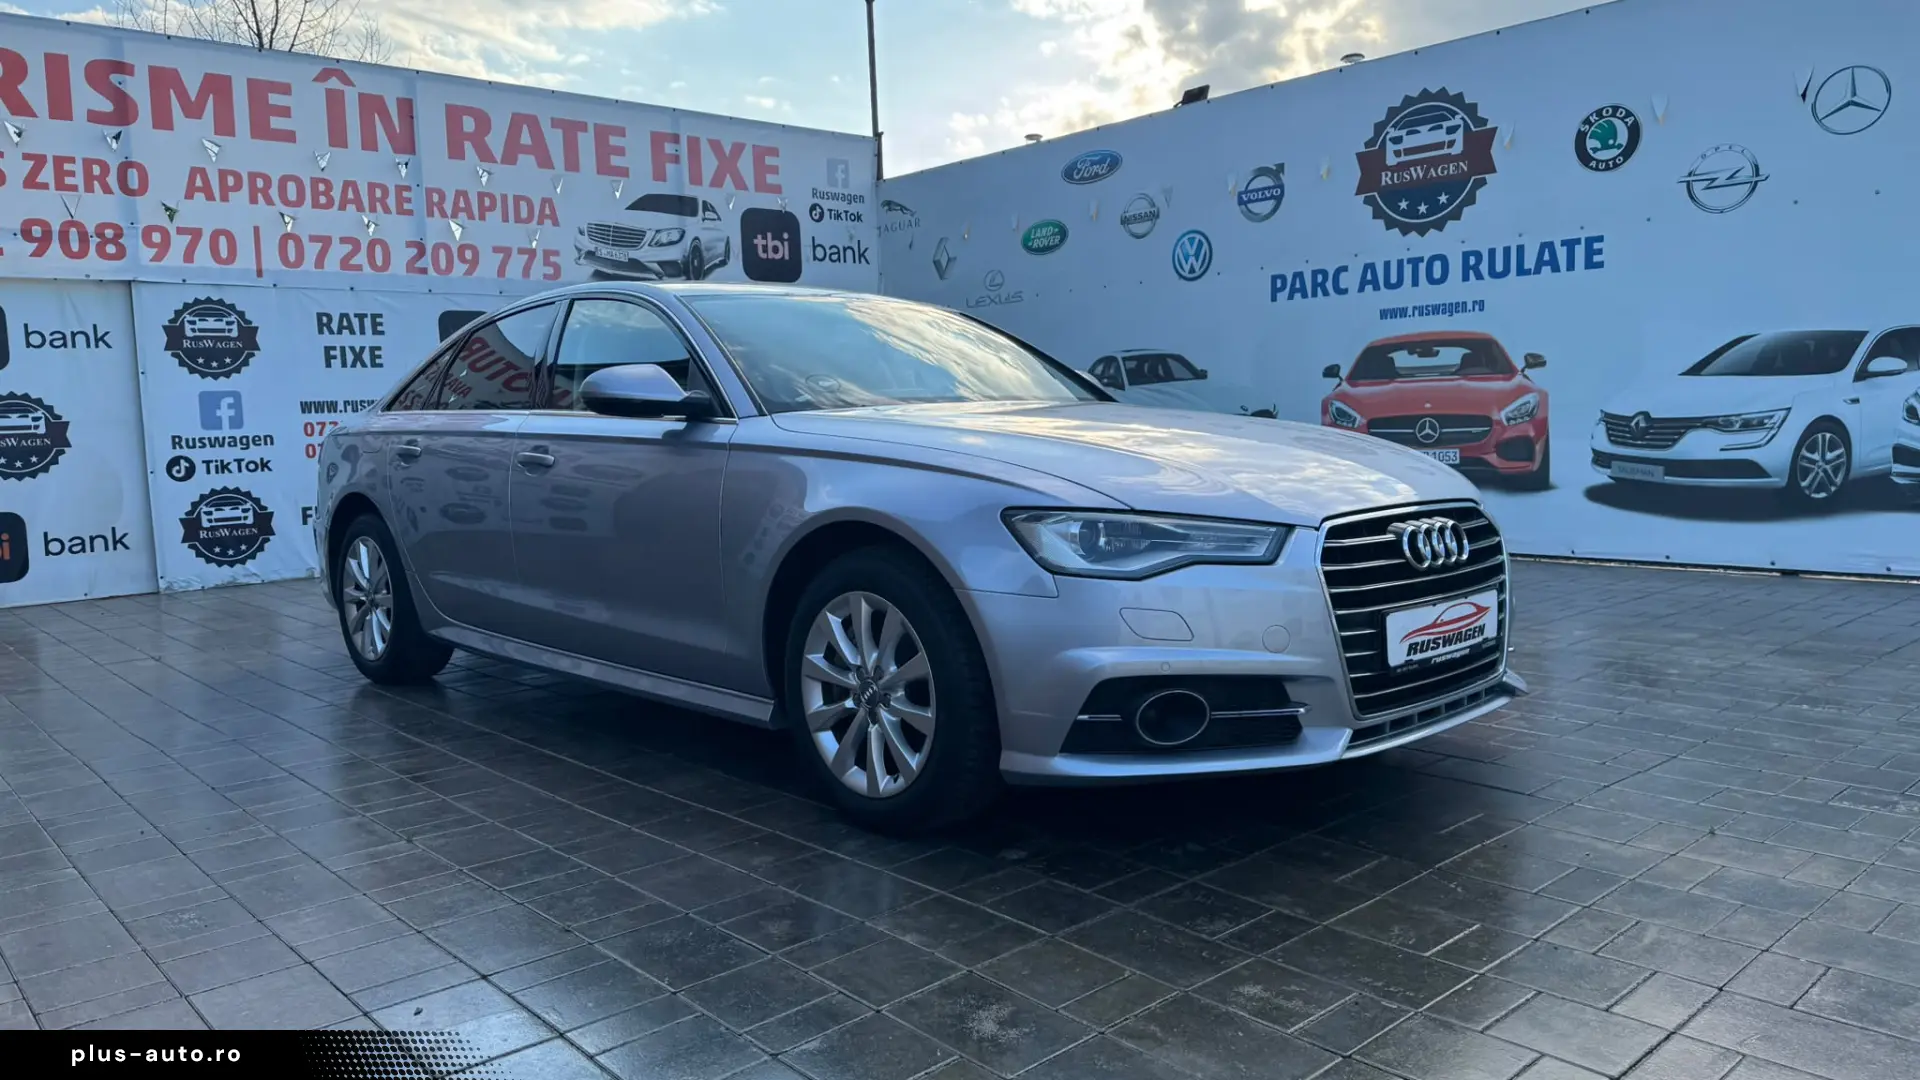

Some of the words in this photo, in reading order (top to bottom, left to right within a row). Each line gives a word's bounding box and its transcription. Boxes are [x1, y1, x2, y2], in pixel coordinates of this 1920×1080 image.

[312, 67, 417, 156] ÎN
[444, 103, 630, 178] RATE
[649, 130, 783, 195] FIXE
[1073, 156, 1111, 180] Ford
[1588, 156, 1624, 170] AUTO
[22, 152, 150, 197] ZERO
[184, 166, 415, 217] APROBARE
[425, 186, 561, 228] RAPIDA
[811, 187, 865, 205] Ruswagen
[1241, 186, 1282, 201] VOLVO
[827, 208, 863, 223] TikTok
[1124, 209, 1156, 222] NISSAN
[876, 218, 922, 239] JAGUAR
[20, 217, 127, 262] 908
[141, 224, 238, 266] 970
[278, 232, 392, 273] 0720
[405, 240, 480, 277] 209
[491, 245, 562, 282] 775
[753, 232, 790, 261] tbi
[811, 236, 871, 265] bank
[1032, 235, 1061, 249] ROVER
[1269, 265, 1350, 303] PARC
[1357, 251, 1451, 295] AUTO
[1461, 233, 1606, 282] RULATE
[966, 290, 1024, 309] LEXUS
[1379, 299, 1485, 320] www.ruswagen.ro
[23, 323, 113, 350] bank
[316, 312, 386, 337] RATE
[323, 345, 385, 369] FIXE
[170, 433, 275, 452] Ruswagen
[202, 457, 273, 476] TikTok
[43, 526, 131, 556] bank
[1406, 623, 1486, 657] RUSWAGEN
